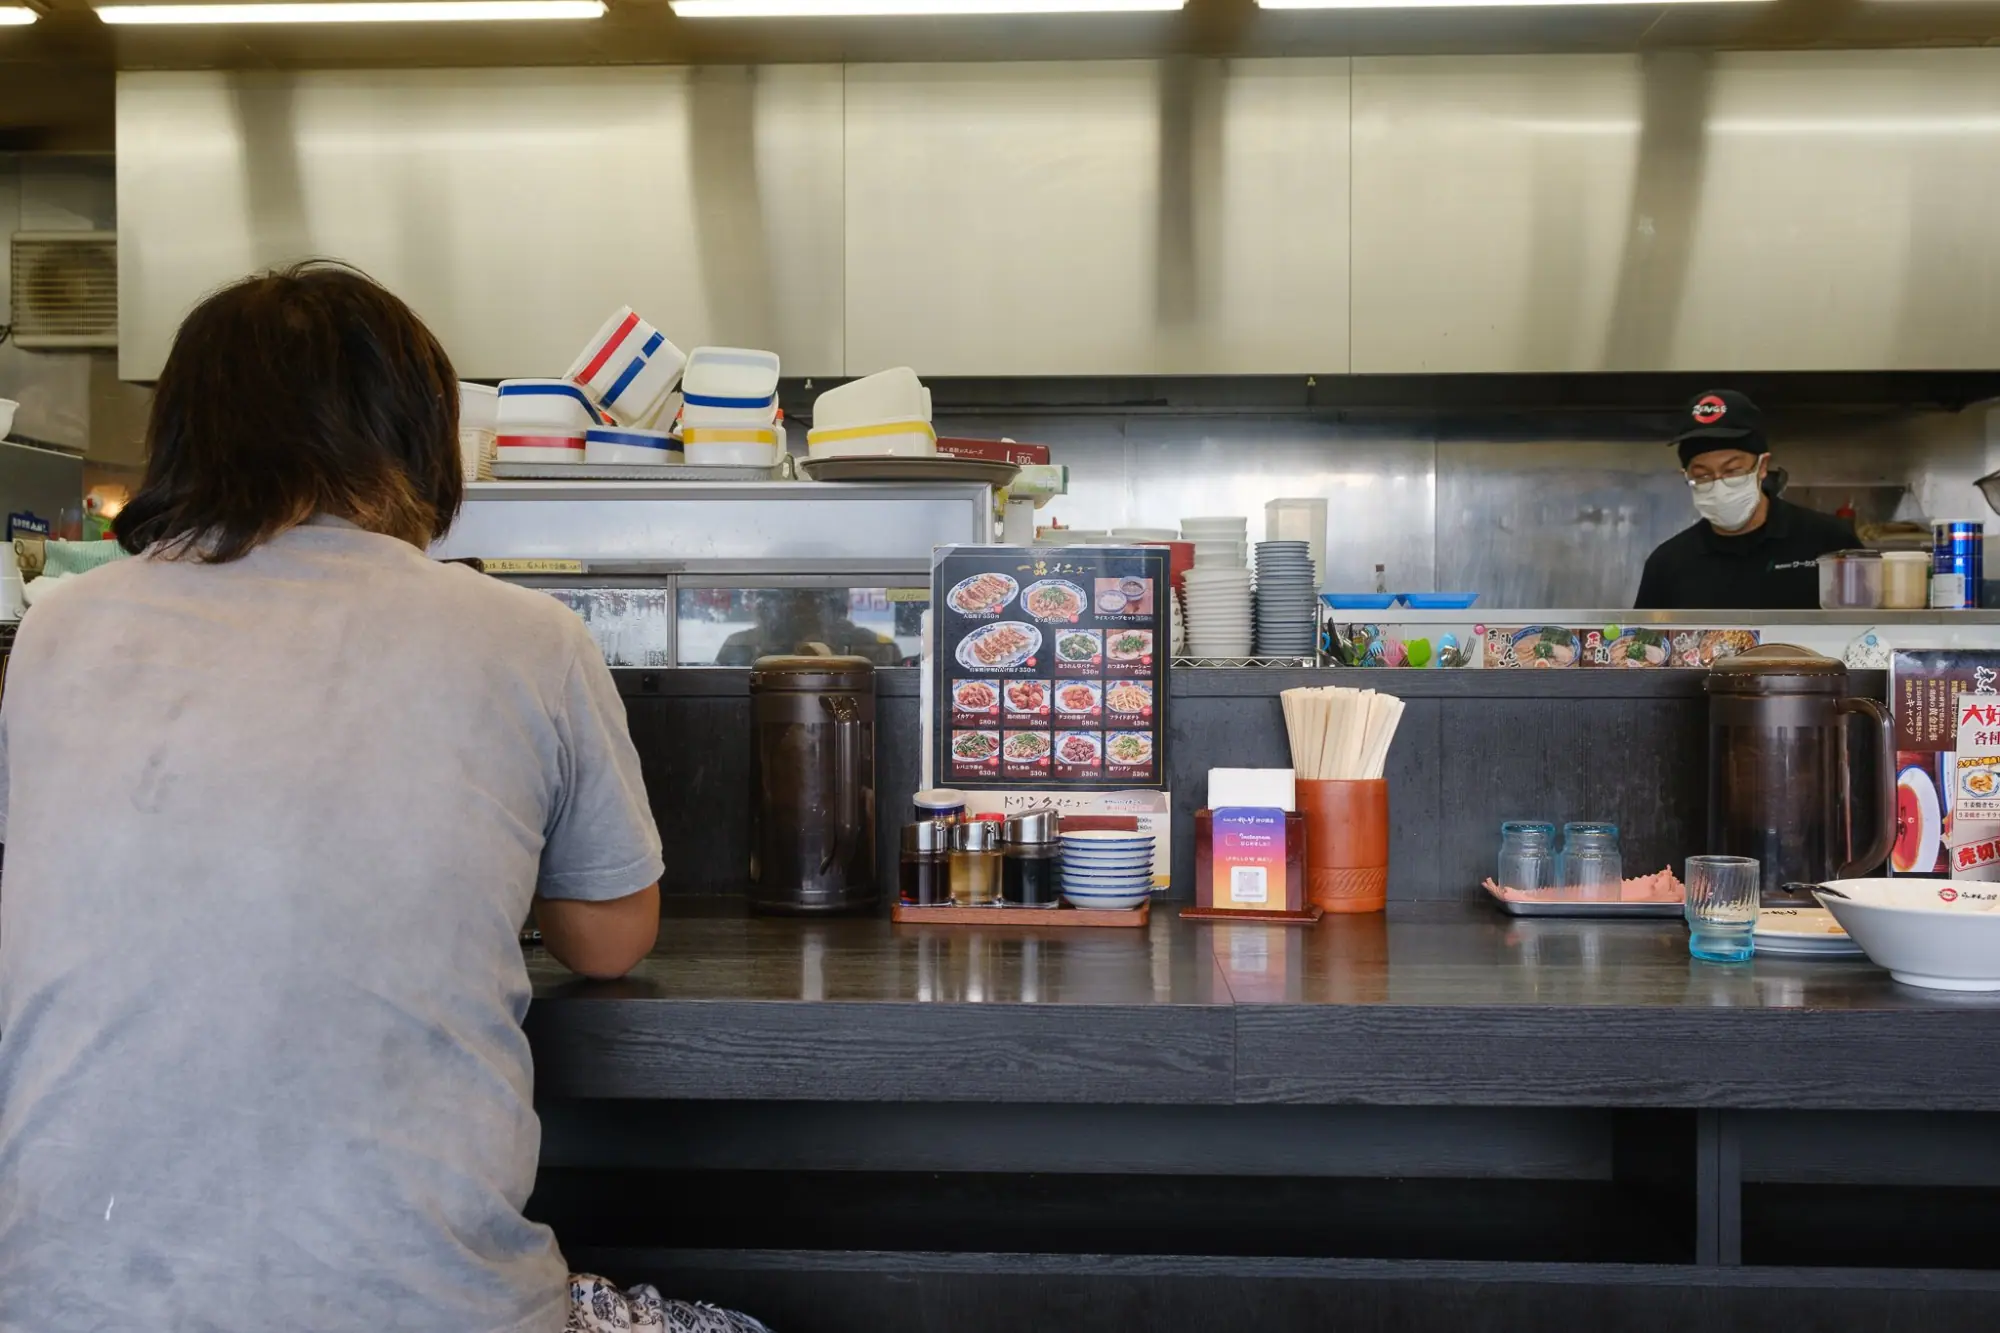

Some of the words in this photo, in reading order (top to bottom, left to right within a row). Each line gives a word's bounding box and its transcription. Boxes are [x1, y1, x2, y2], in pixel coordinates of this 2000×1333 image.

[1016, 560, 1097, 577] 一品メニュー
